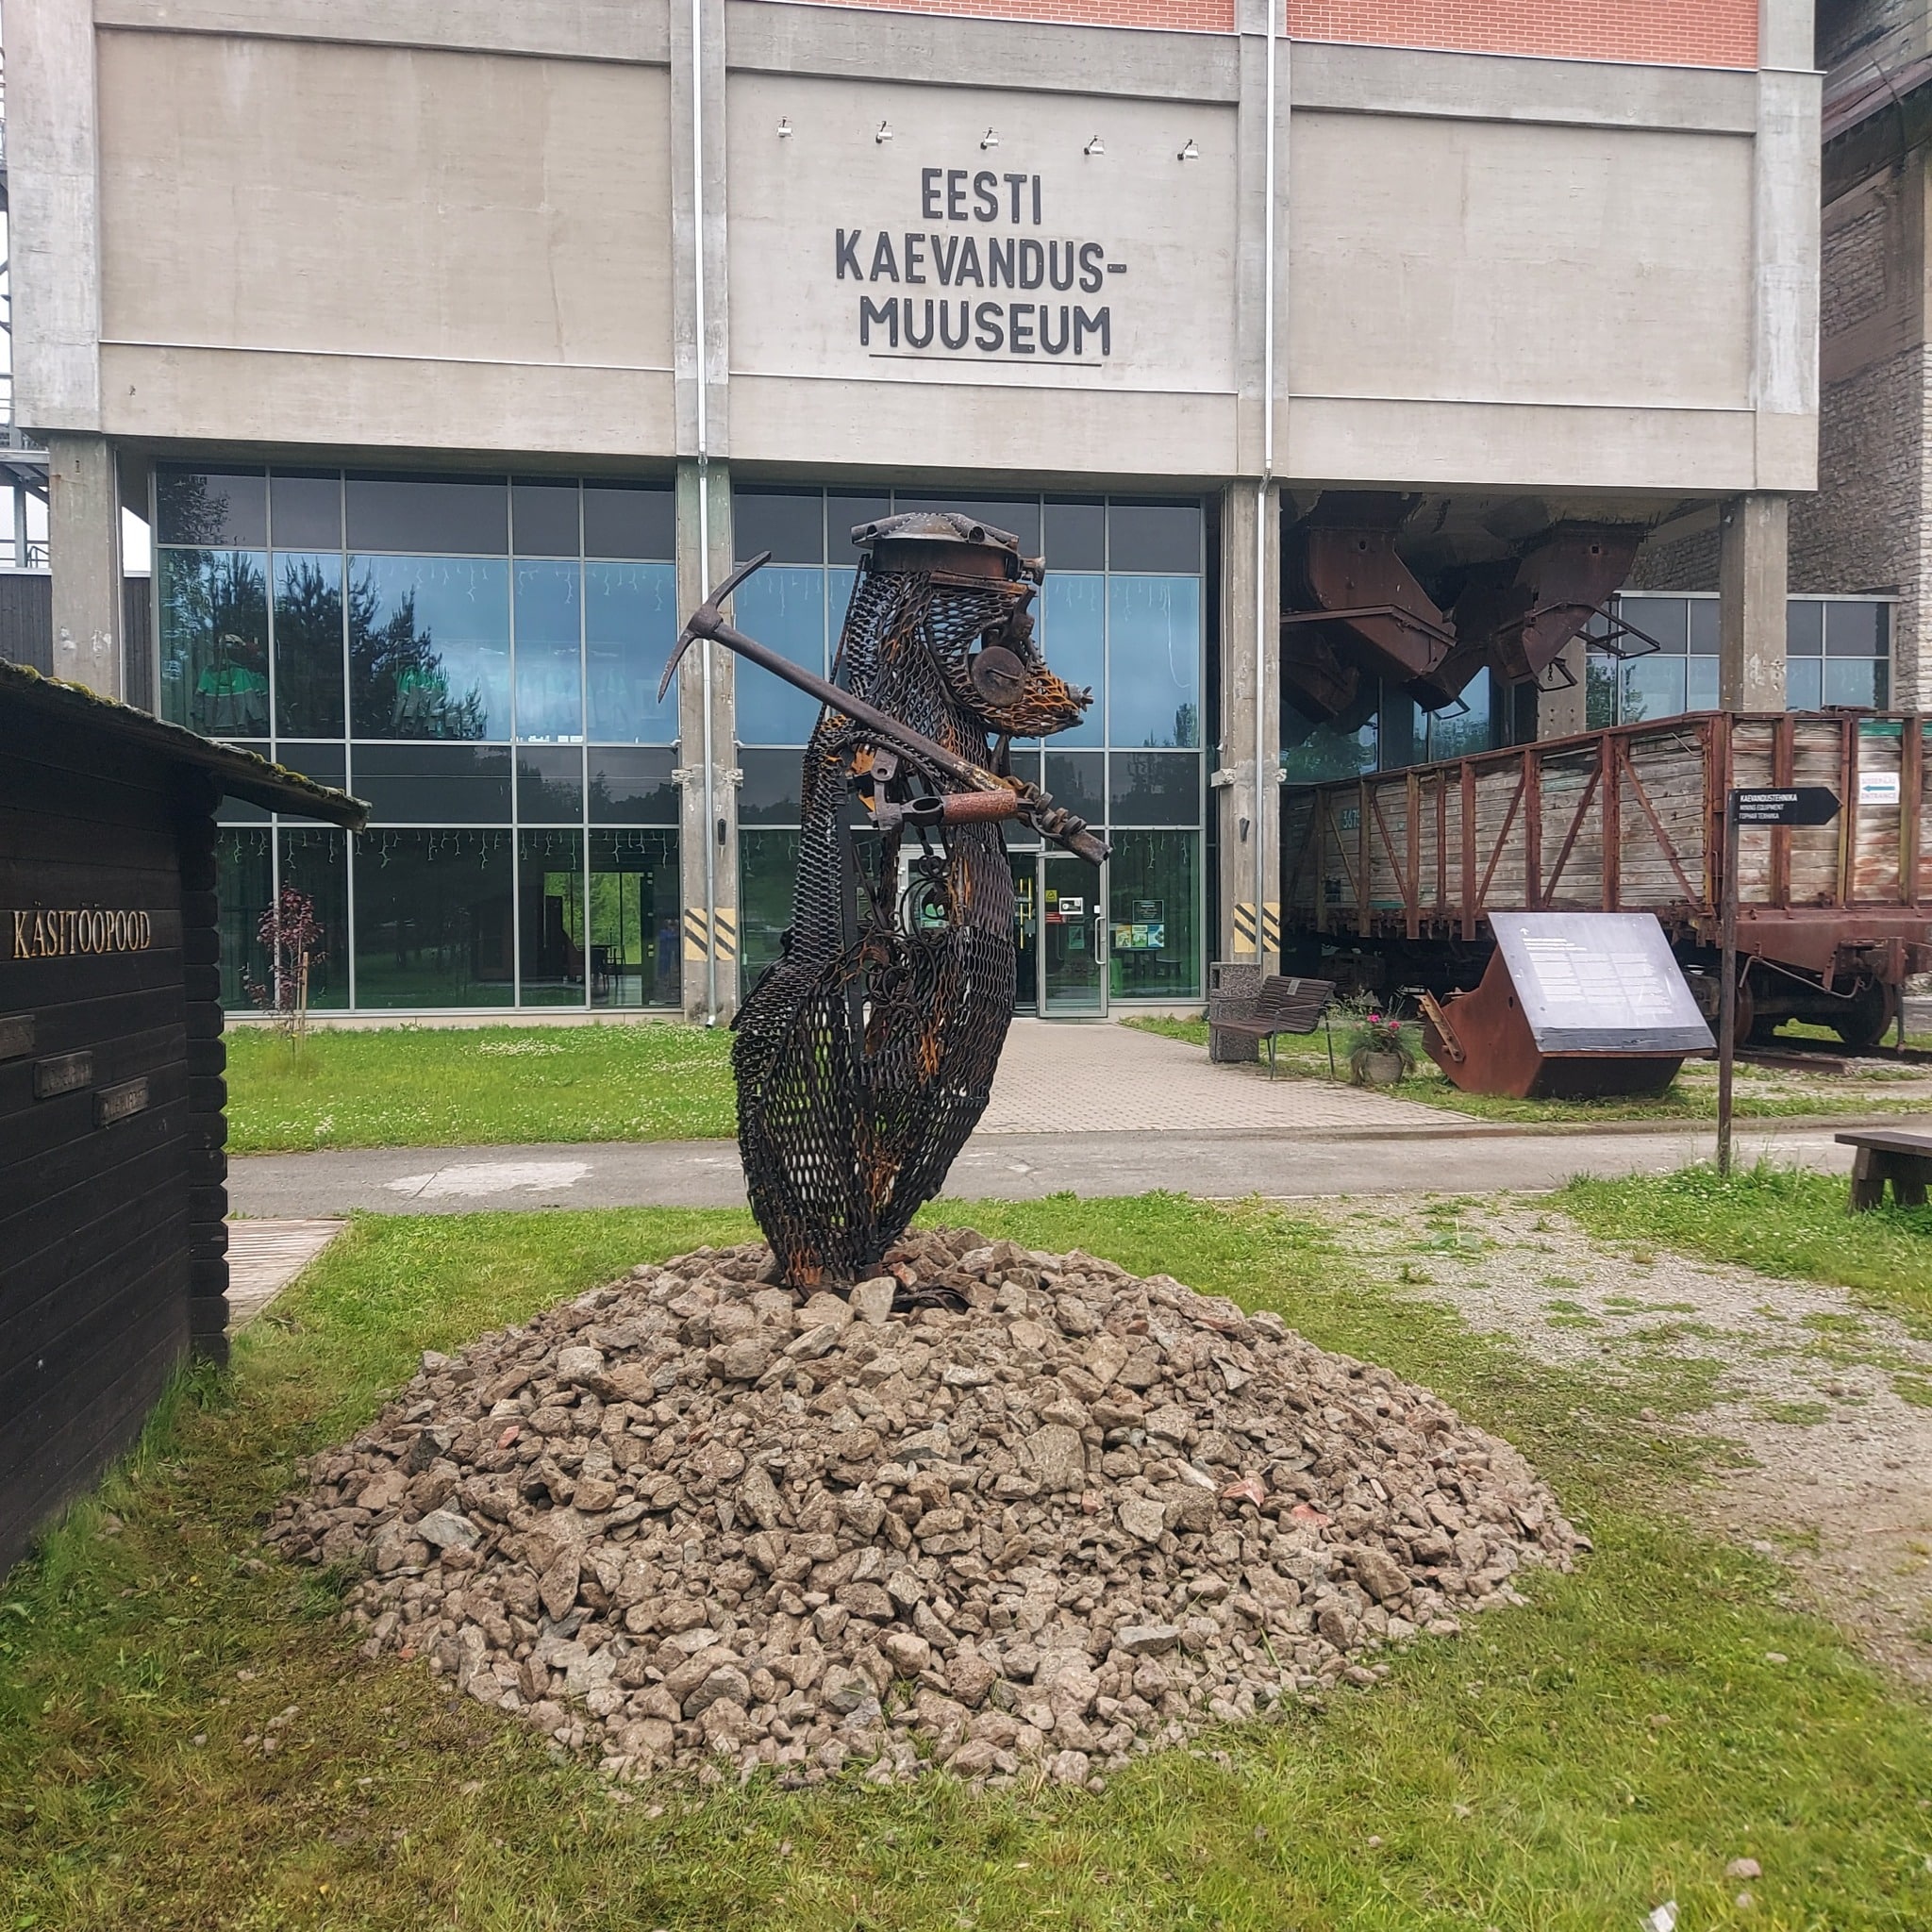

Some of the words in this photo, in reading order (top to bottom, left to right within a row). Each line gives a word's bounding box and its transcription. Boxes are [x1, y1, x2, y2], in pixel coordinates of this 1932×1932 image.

[922, 168, 1041, 225] EESTI
[836, 228, 1127, 293] KAEVANDUS-
[860, 295, 1110, 356] MUUSEUM
